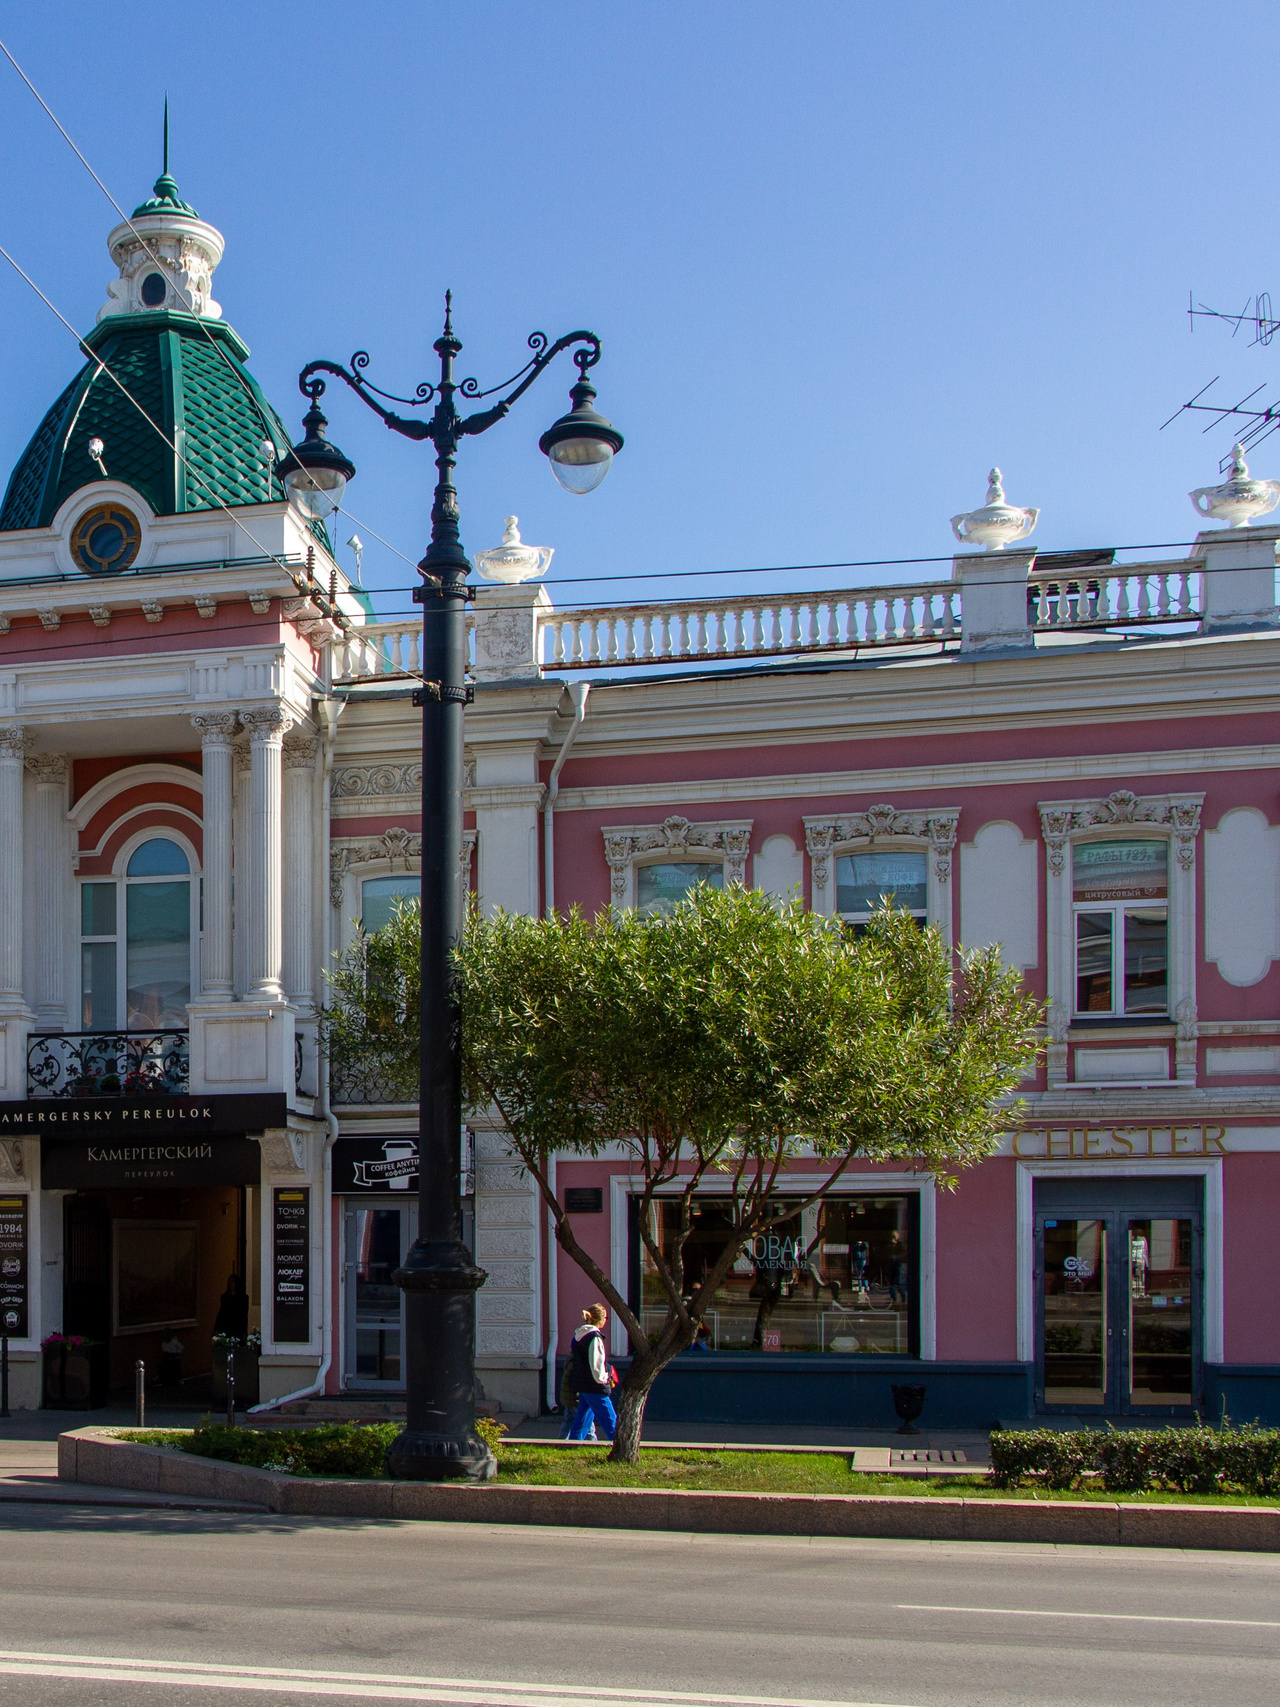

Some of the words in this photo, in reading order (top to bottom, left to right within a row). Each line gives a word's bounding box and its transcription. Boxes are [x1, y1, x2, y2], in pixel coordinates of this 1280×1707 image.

[1084, 889, 1141, 899] цитрусовый
[122, 1107, 213, 1120] PEREULOK
[1012, 1123, 1230, 1160] CHESTER
[370, 1162, 396, 1172] COFFEE
[385, 1167, 416, 1177] кофейня
[0, 1223, 23, 1234] 1984
